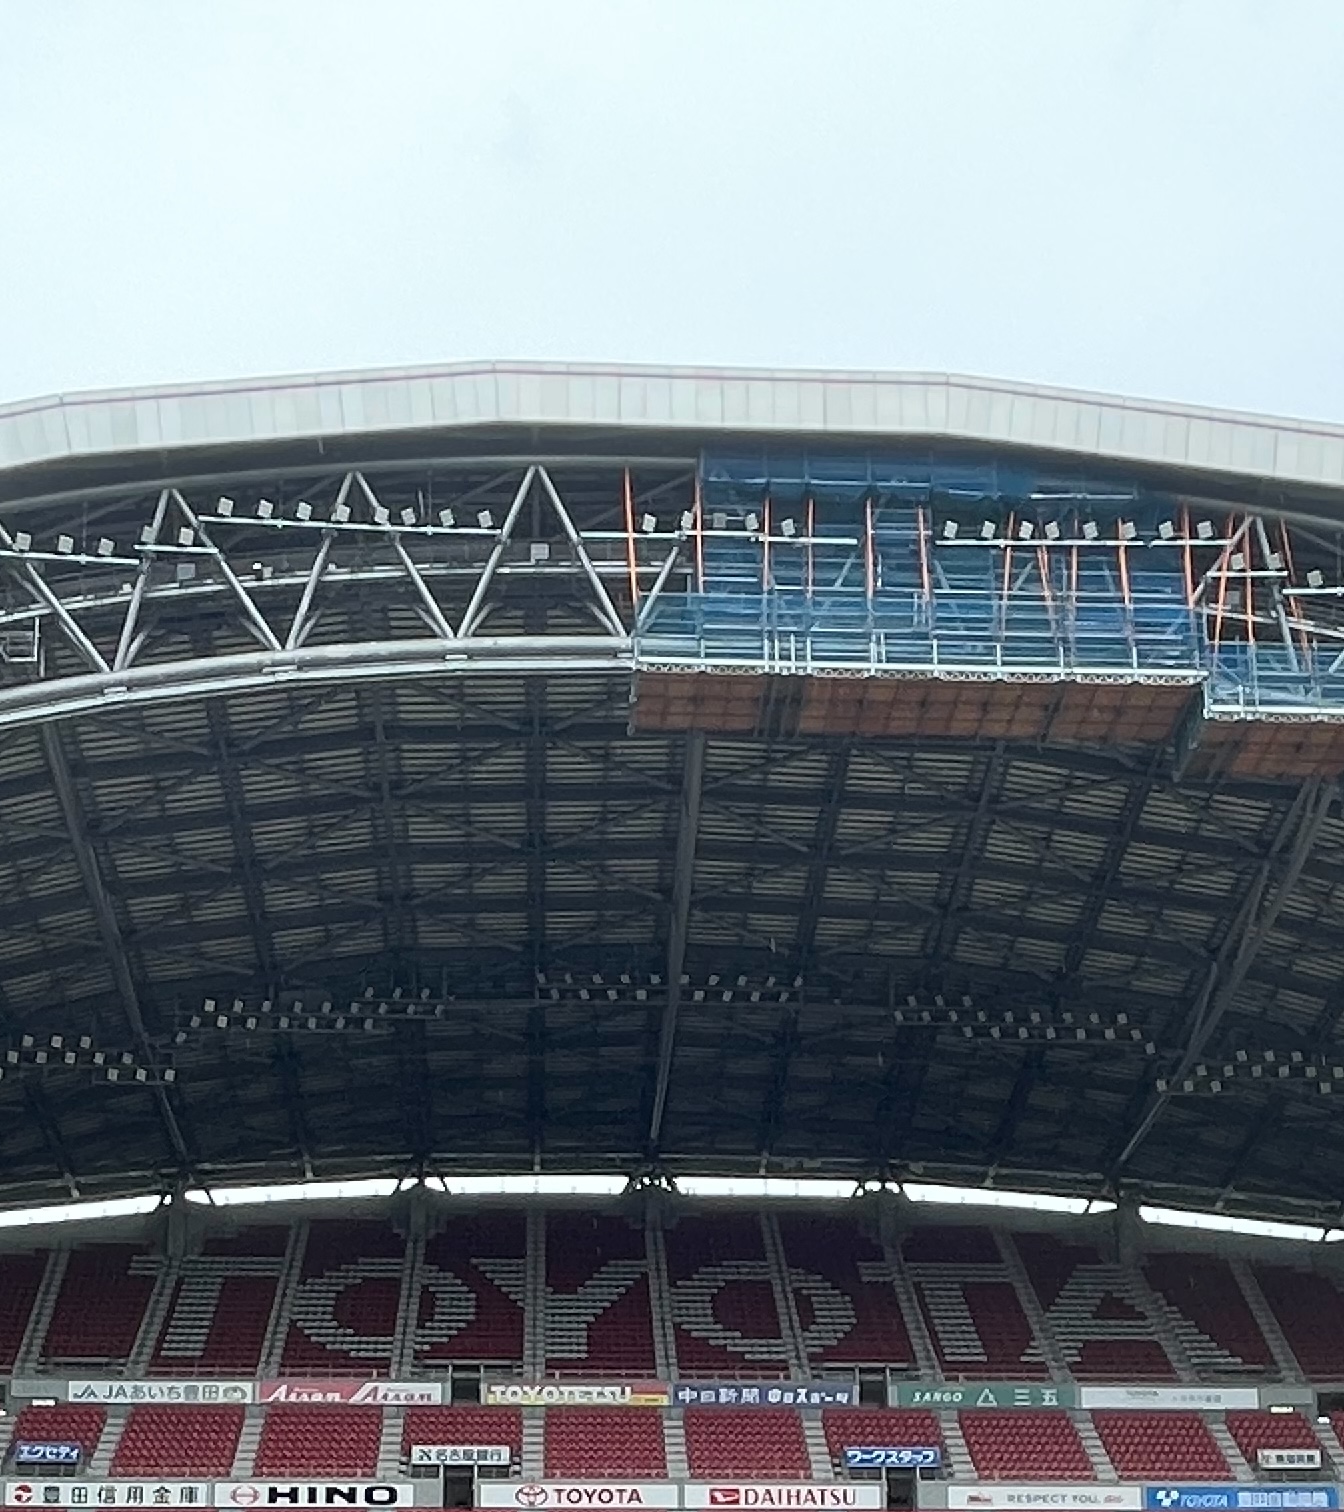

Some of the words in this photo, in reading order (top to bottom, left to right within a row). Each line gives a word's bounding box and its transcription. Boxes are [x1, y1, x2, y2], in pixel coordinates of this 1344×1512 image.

[129, 1256, 1266, 1373] TOYOTA
[267, 1486, 397, 1504] HINO
[553, 1488, 643, 1504] TOYOTA
[744, 1488, 856, 1506] DAIHATSU
